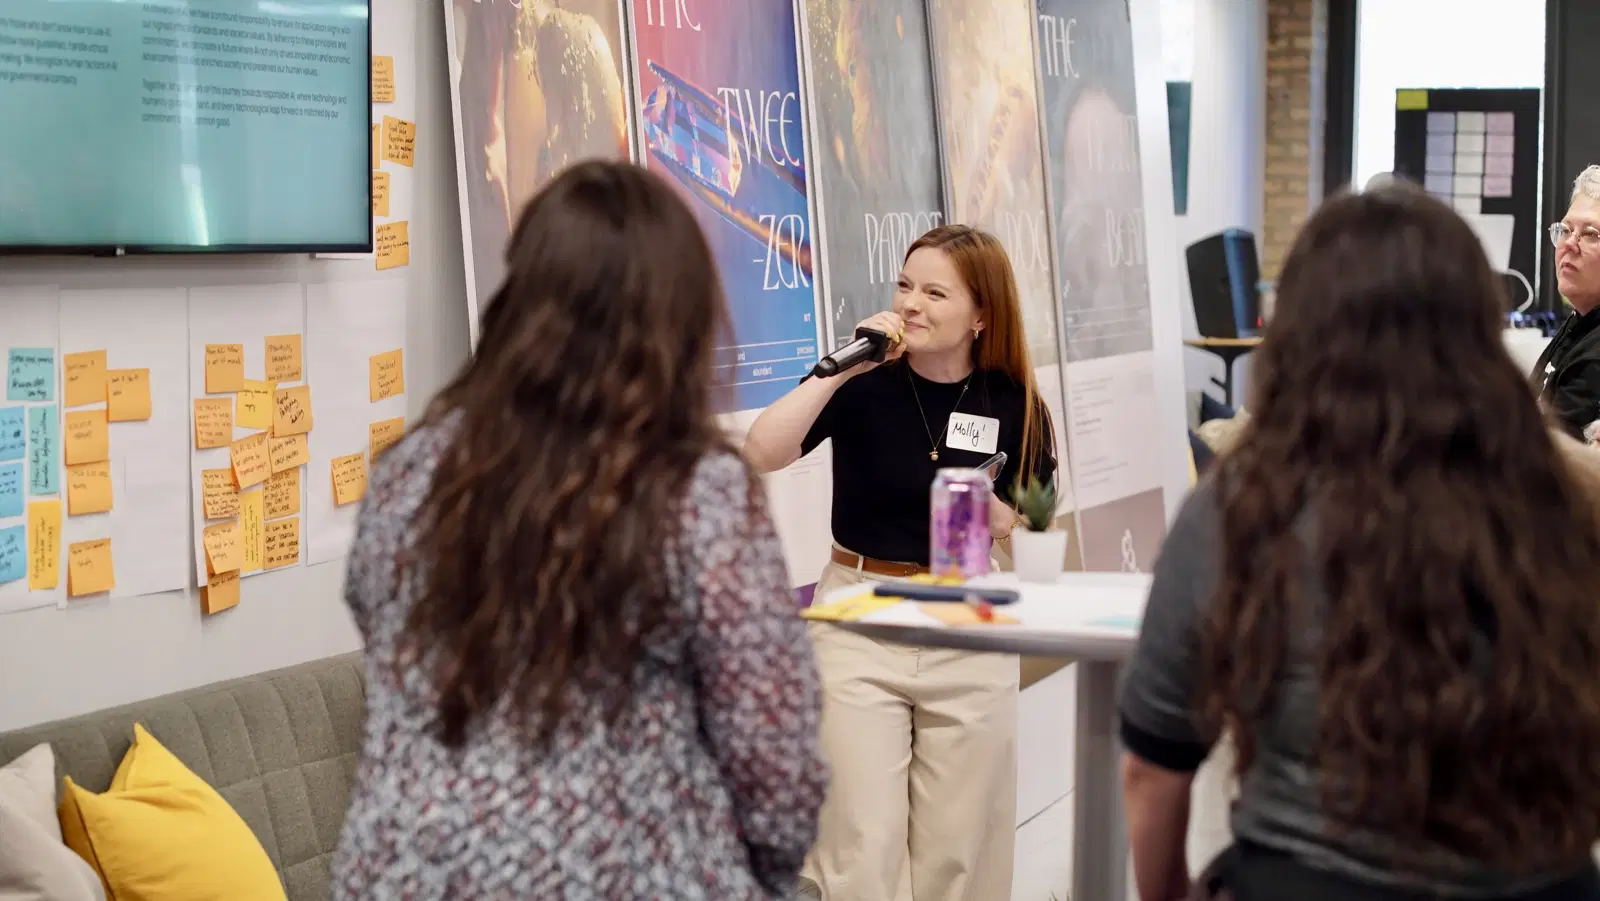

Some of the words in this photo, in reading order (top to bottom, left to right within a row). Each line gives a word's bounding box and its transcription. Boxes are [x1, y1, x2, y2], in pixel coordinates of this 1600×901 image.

[1039, 15, 1080, 78] THE
[717, 87, 800, 167] TWEE
[864, 211, 943, 284] PARR
[952, 421, 986, 447] Molly!
